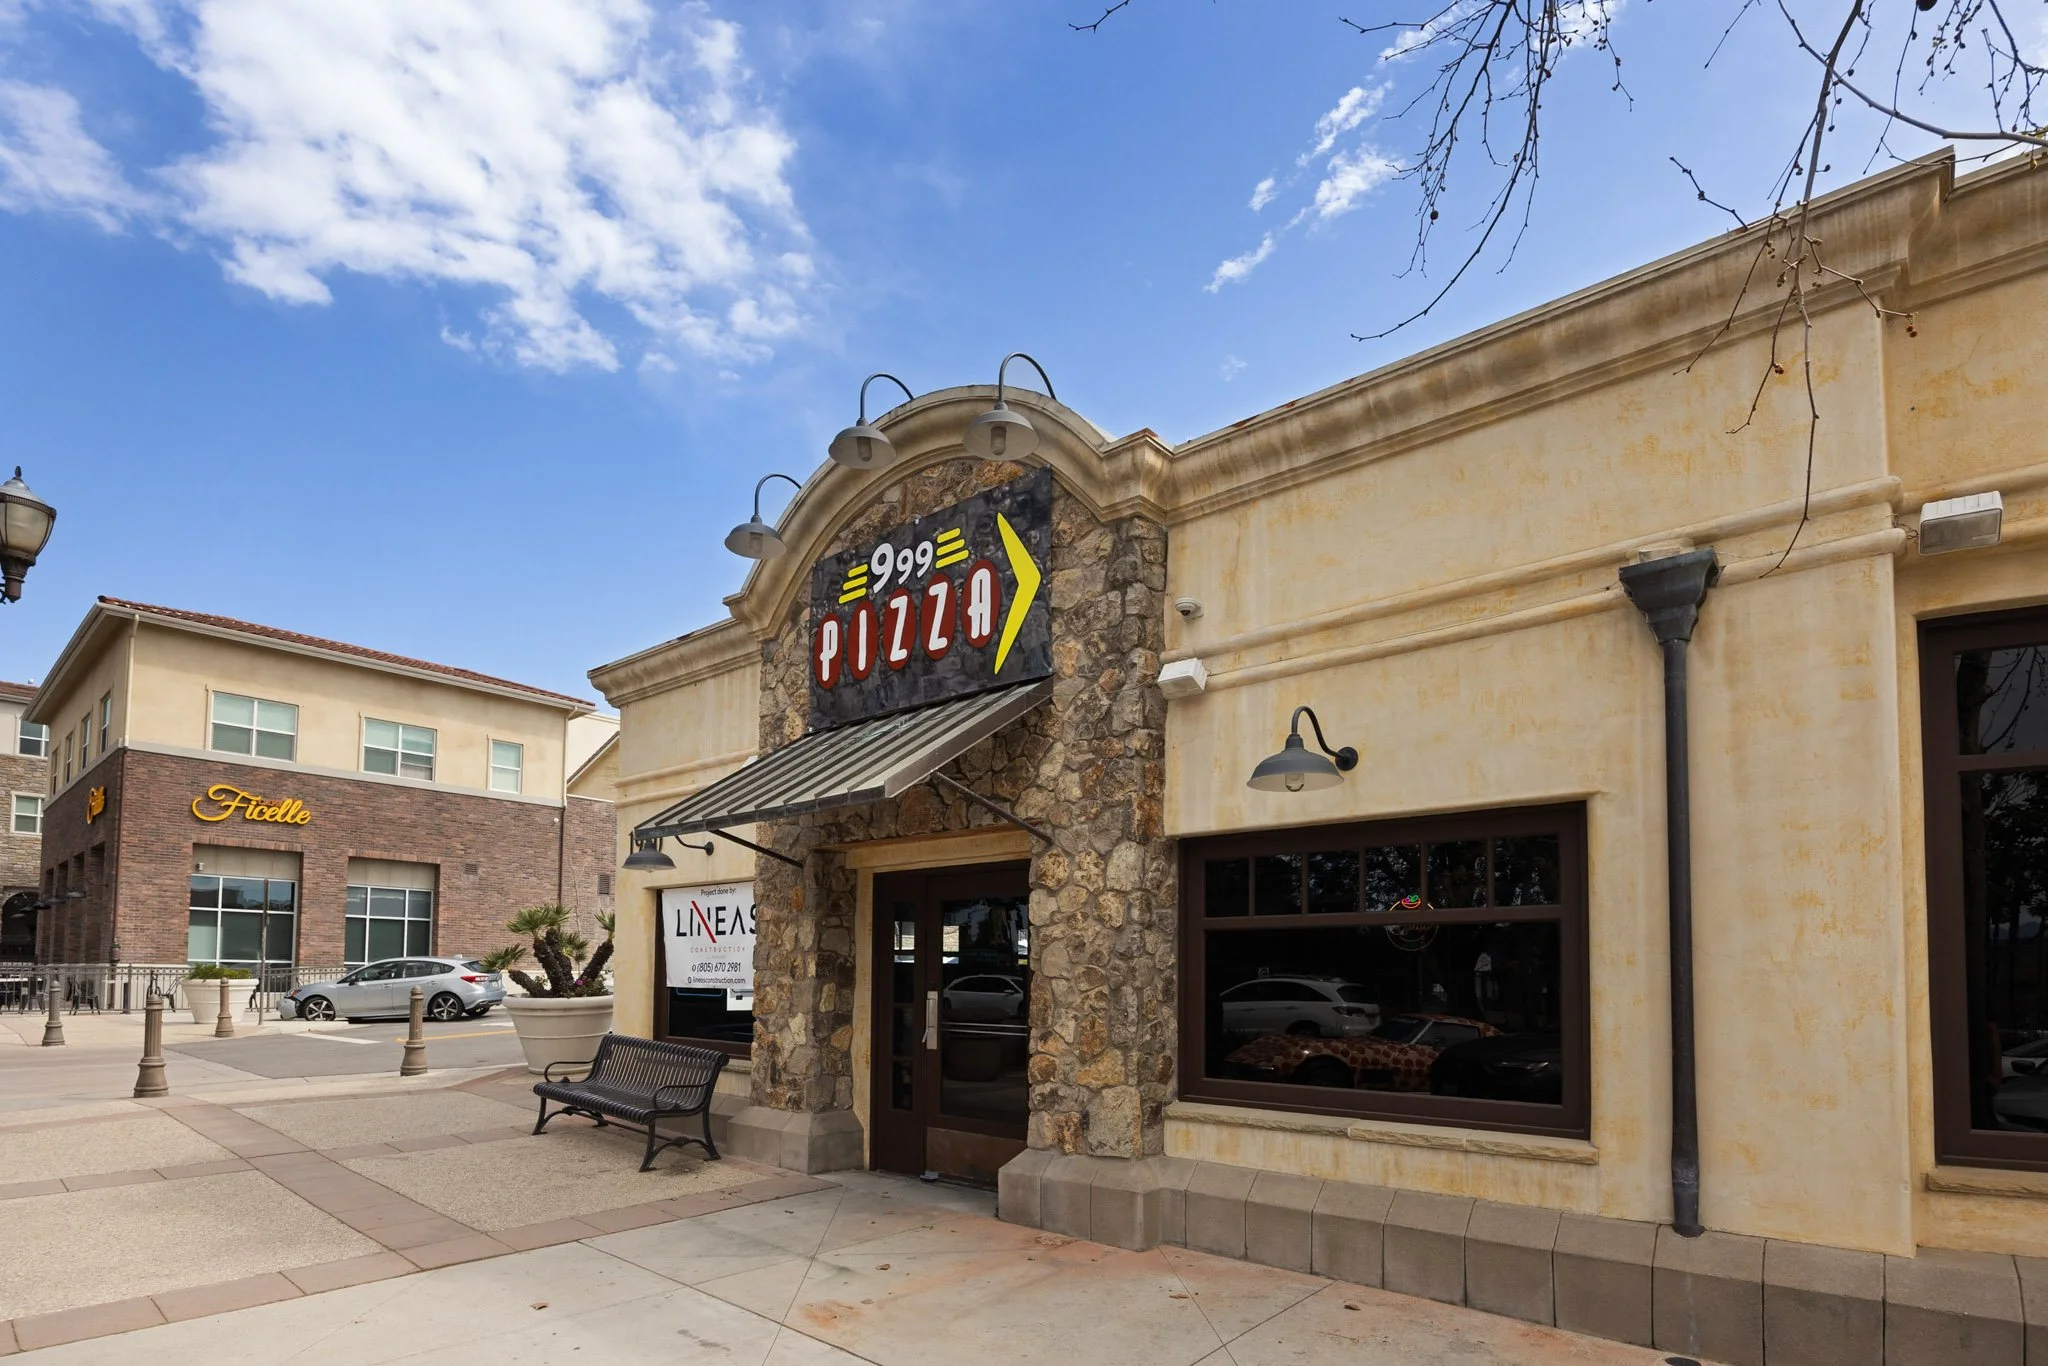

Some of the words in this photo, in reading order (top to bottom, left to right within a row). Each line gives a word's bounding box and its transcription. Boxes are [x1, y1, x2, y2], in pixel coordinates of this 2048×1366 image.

[870, 540, 934, 594] 999
[818, 566, 993, 683] PIZZA
[191, 784, 312, 825] Ficelle
[700, 888, 717, 897] Project
[717, 887, 728, 895] done
[697, 962, 714, 973] (805)
[714, 962, 726, 972] 670
[727, 962, 741, 973] 2981
